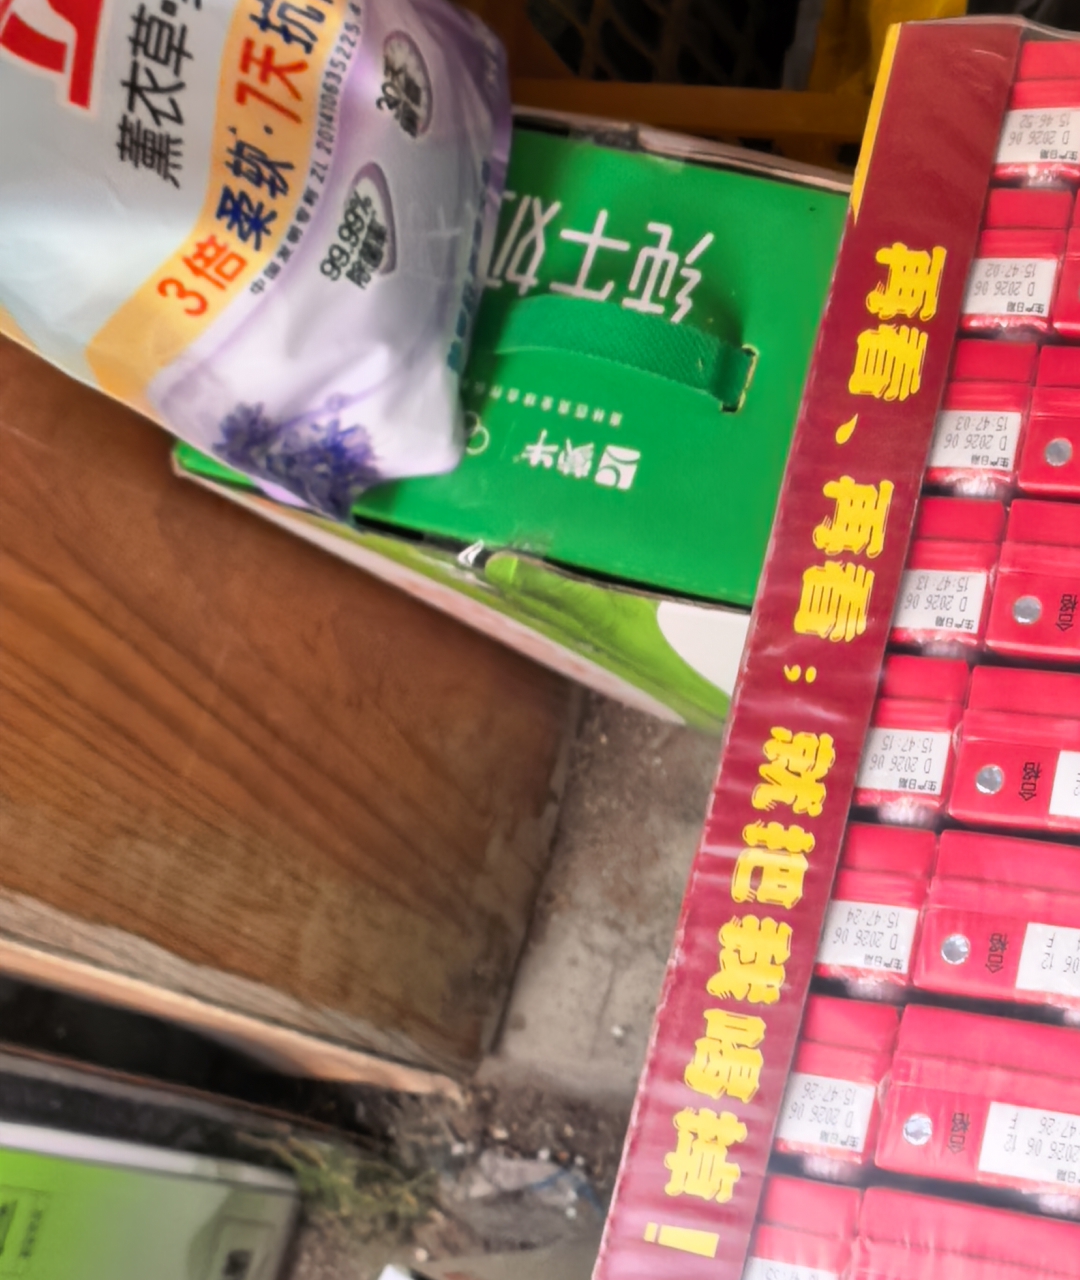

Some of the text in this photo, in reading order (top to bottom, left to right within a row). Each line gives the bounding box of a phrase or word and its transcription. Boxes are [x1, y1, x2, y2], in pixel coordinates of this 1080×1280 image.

[1019, 113, 1071, 129] 15:46:52
[1007, 131, 1025, 147] 06
[1026, 129, 1059, 147] 2026
[1039, 149, 1079, 161] 生产日期
[984, 262, 1038, 280] 15:47:02
[973, 280, 990, 297] 06
[992, 279, 1024, 298] 2026
[1006, 301, 1046, 315] 生产日期
[954, 415, 1009, 433] 15:47:03
[942, 432, 960, 450] 06
[962, 432, 995, 451] 2026
[971, 454, 1010, 469] 生产日期
[914, 574, 970, 594] 15:47:13
[903, 592, 921, 611] 06
[923, 593, 956, 613] 2026
[935, 615, 976, 631] 生产日期
[880, 734, 935, 755] 15:47:15
[868, 752, 886, 771] 06
[887, 754, 920, 774] 2026
[898, 776, 938, 793] 生产日期
